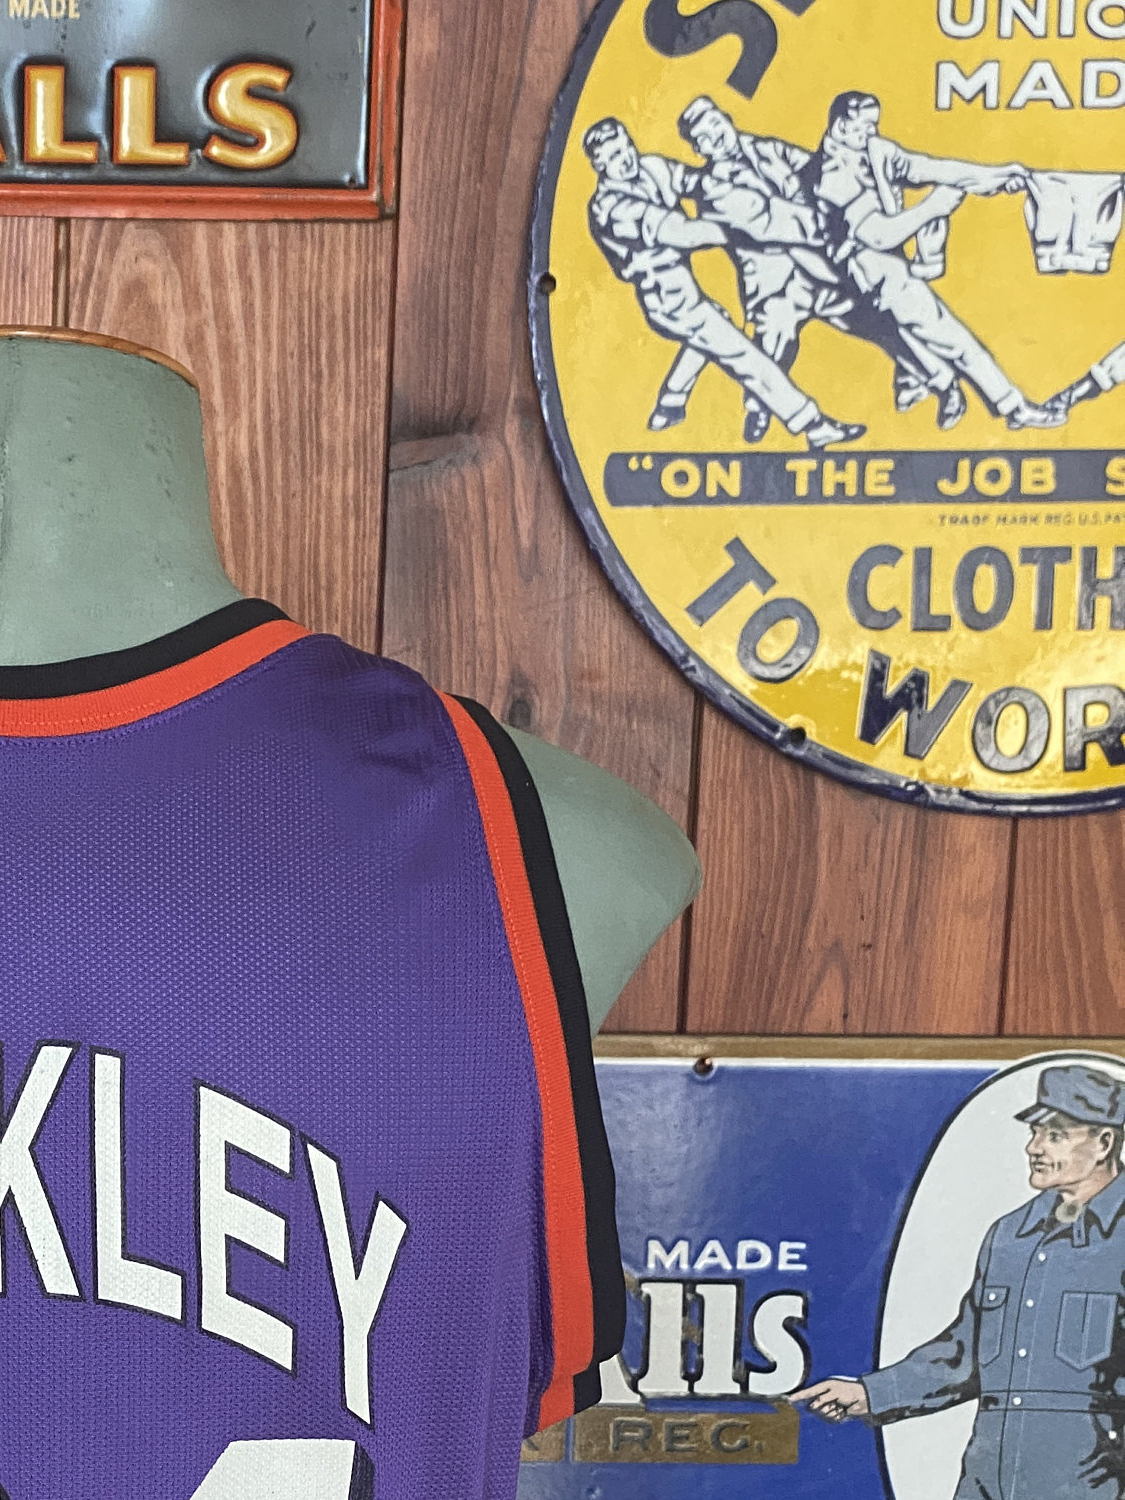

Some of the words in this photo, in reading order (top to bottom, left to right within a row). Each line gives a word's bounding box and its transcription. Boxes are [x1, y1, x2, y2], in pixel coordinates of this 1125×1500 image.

[9, 0, 81, 19] MADE
[786, 459, 895, 497] THE
[937, 457, 1056, 497] JOB
[846, 544, 1125, 632] CLOTH
[685, 537, 820, 682] TO
[858, 648, 1125, 774] WOR
[647, 1239, 808, 1271] MADE
[598, 1281, 808, 1404] lls
